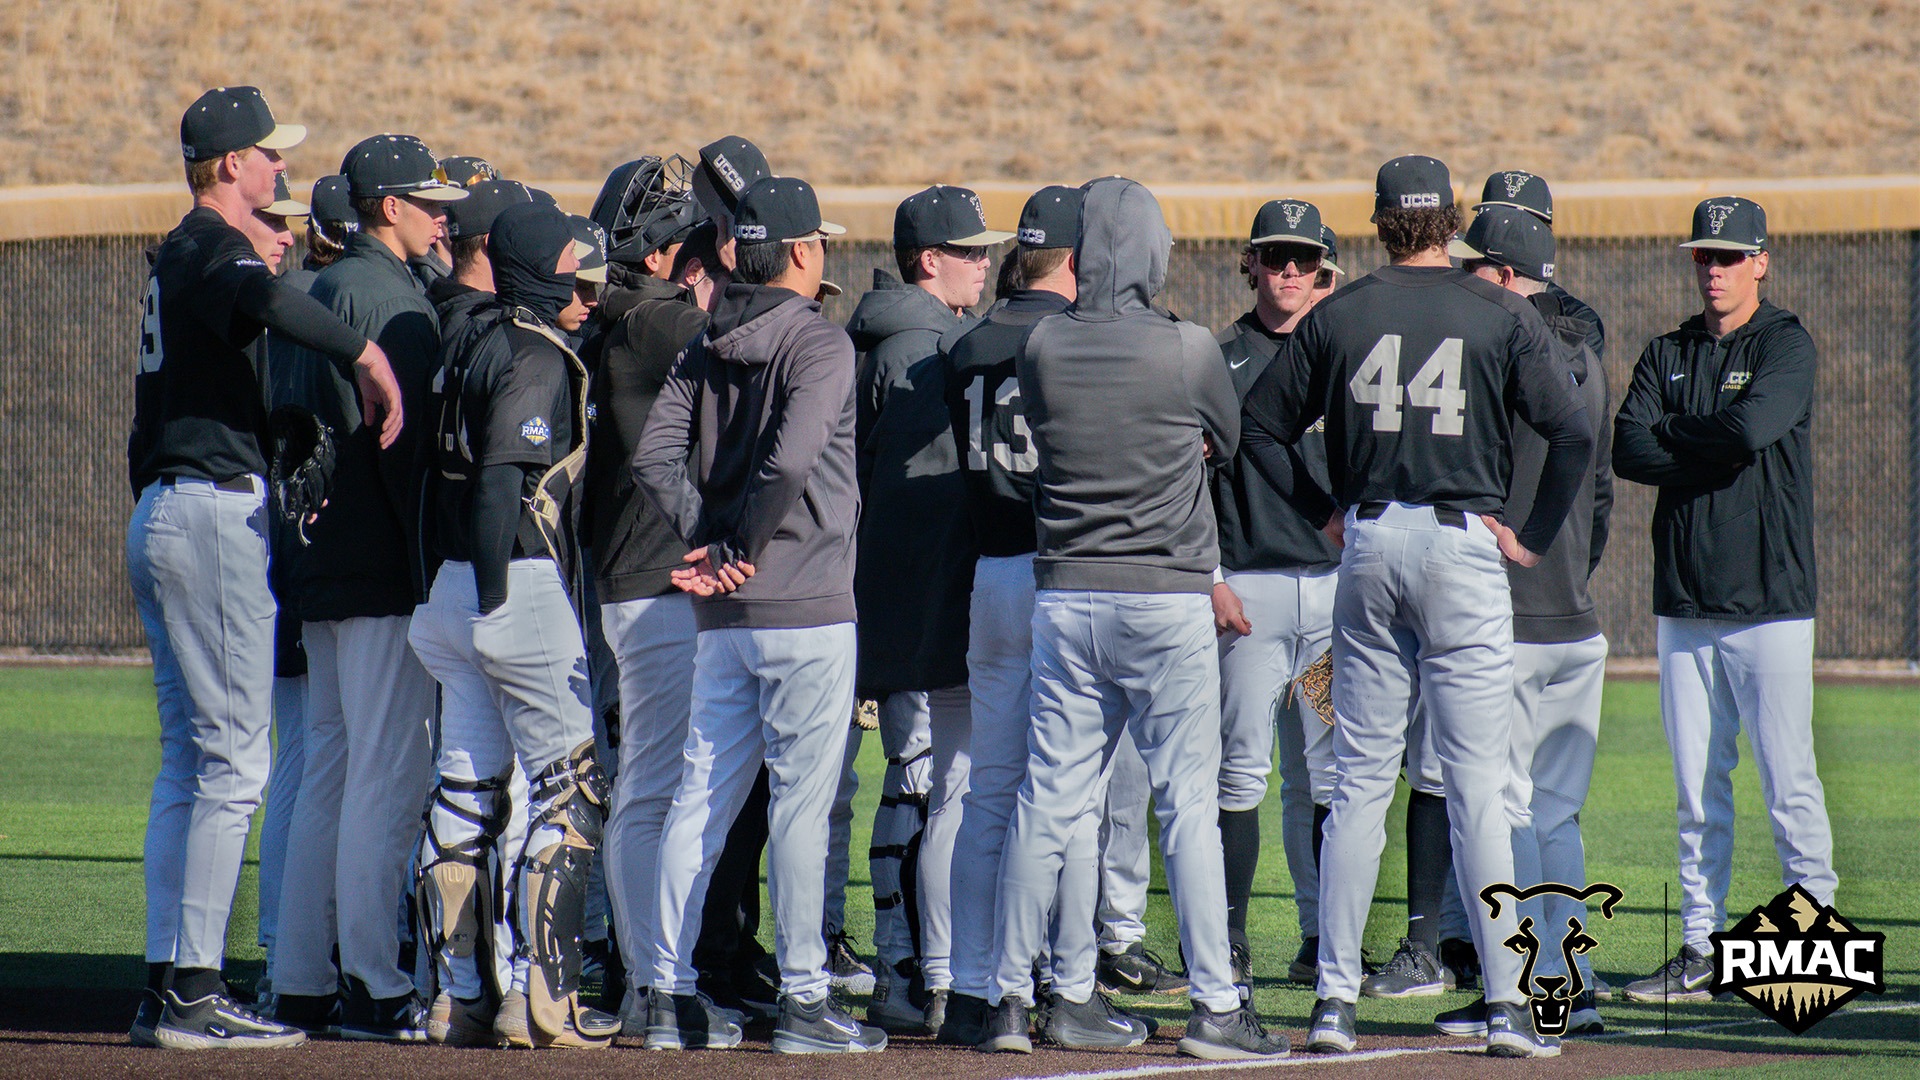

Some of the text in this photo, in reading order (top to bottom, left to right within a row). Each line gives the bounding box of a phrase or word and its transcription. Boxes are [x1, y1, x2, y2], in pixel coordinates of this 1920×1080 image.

[713, 153, 745, 191] UCCS
[1400, 192, 1440, 208] UCCS
[735, 224, 767, 240] UCCS
[1349, 334, 1466, 436] 44
[521, 424, 549, 438] RMAC
[964, 374, 1039, 473] 13
